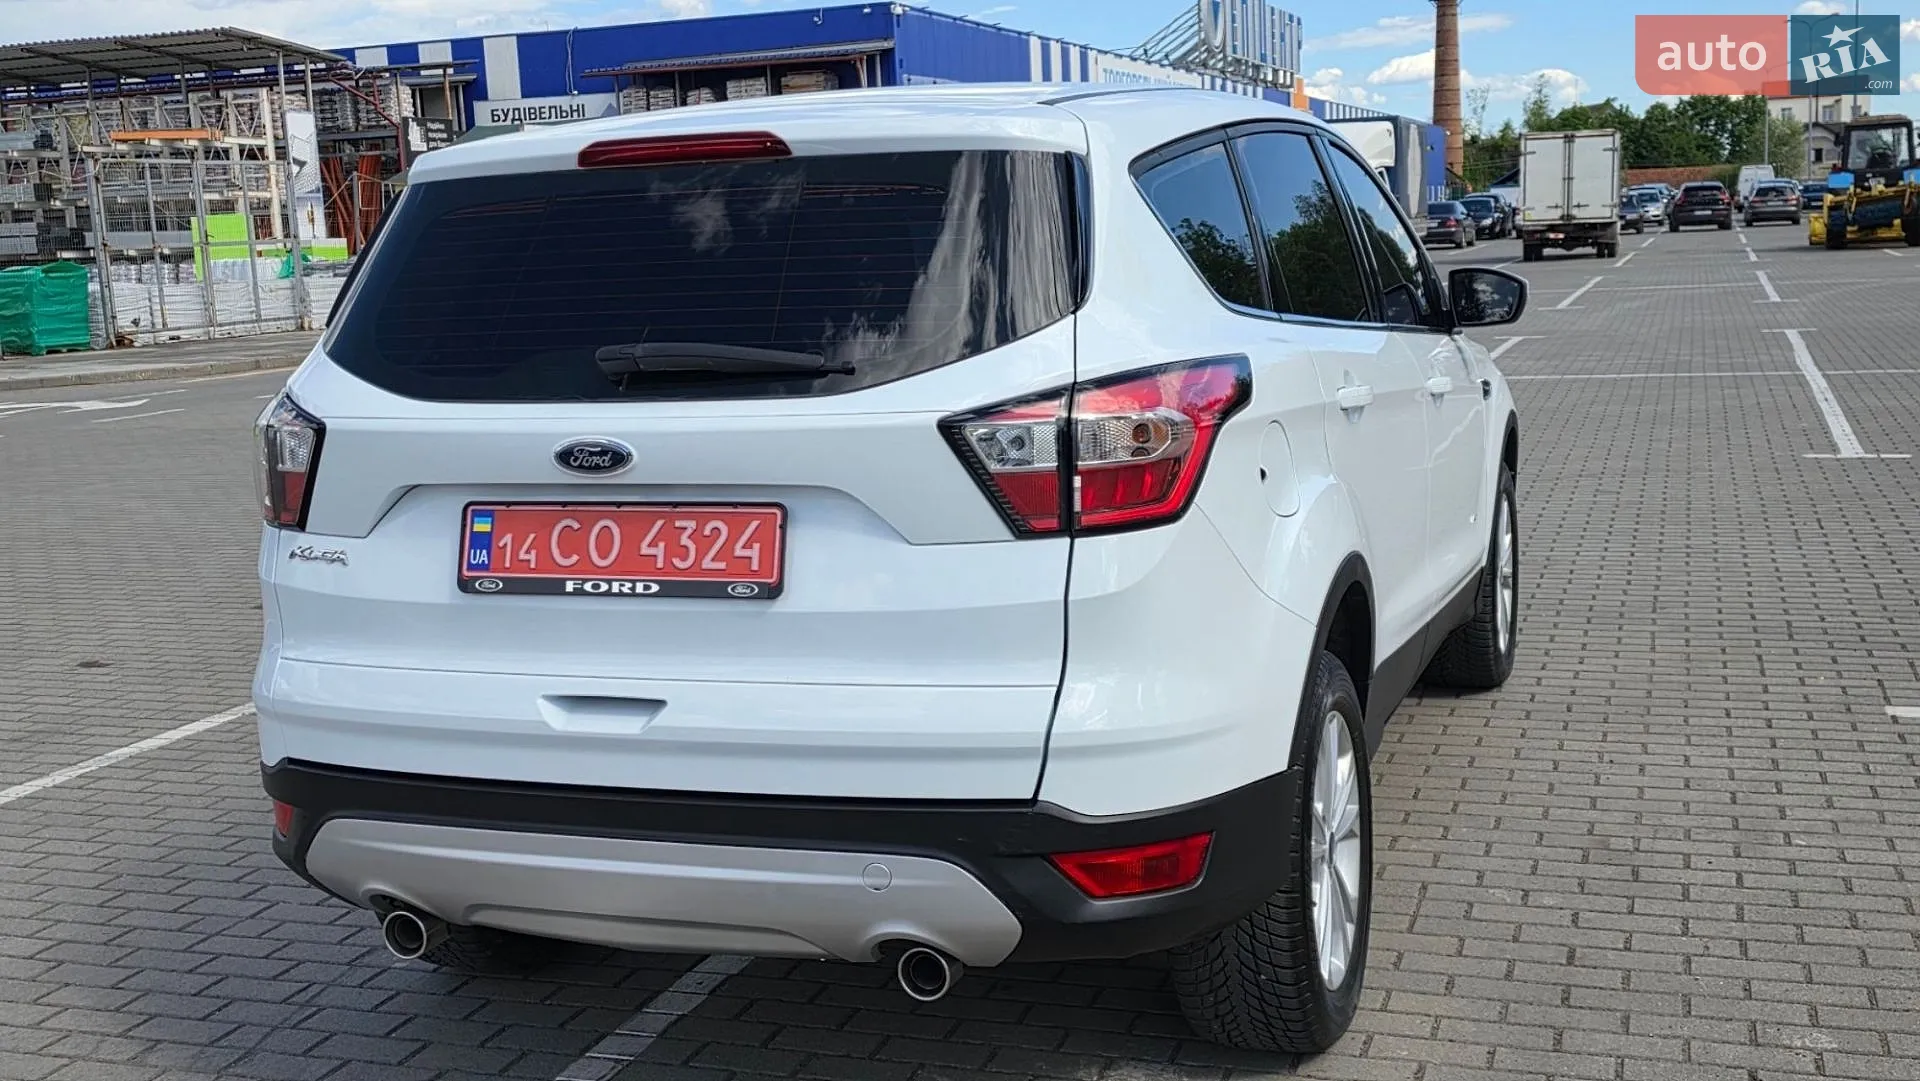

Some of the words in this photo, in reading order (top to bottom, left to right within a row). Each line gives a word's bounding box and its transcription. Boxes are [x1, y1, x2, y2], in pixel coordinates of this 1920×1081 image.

[490, 103, 586, 124] БУДІВЕЛЬНІ
[570, 446, 612, 467] Ford
[498, 533, 537, 569] 14
[551, 518, 621, 568] CO
[639, 519, 761, 571] 4324
[470, 549, 488, 564] UA
[565, 580, 660, 594] FORD
